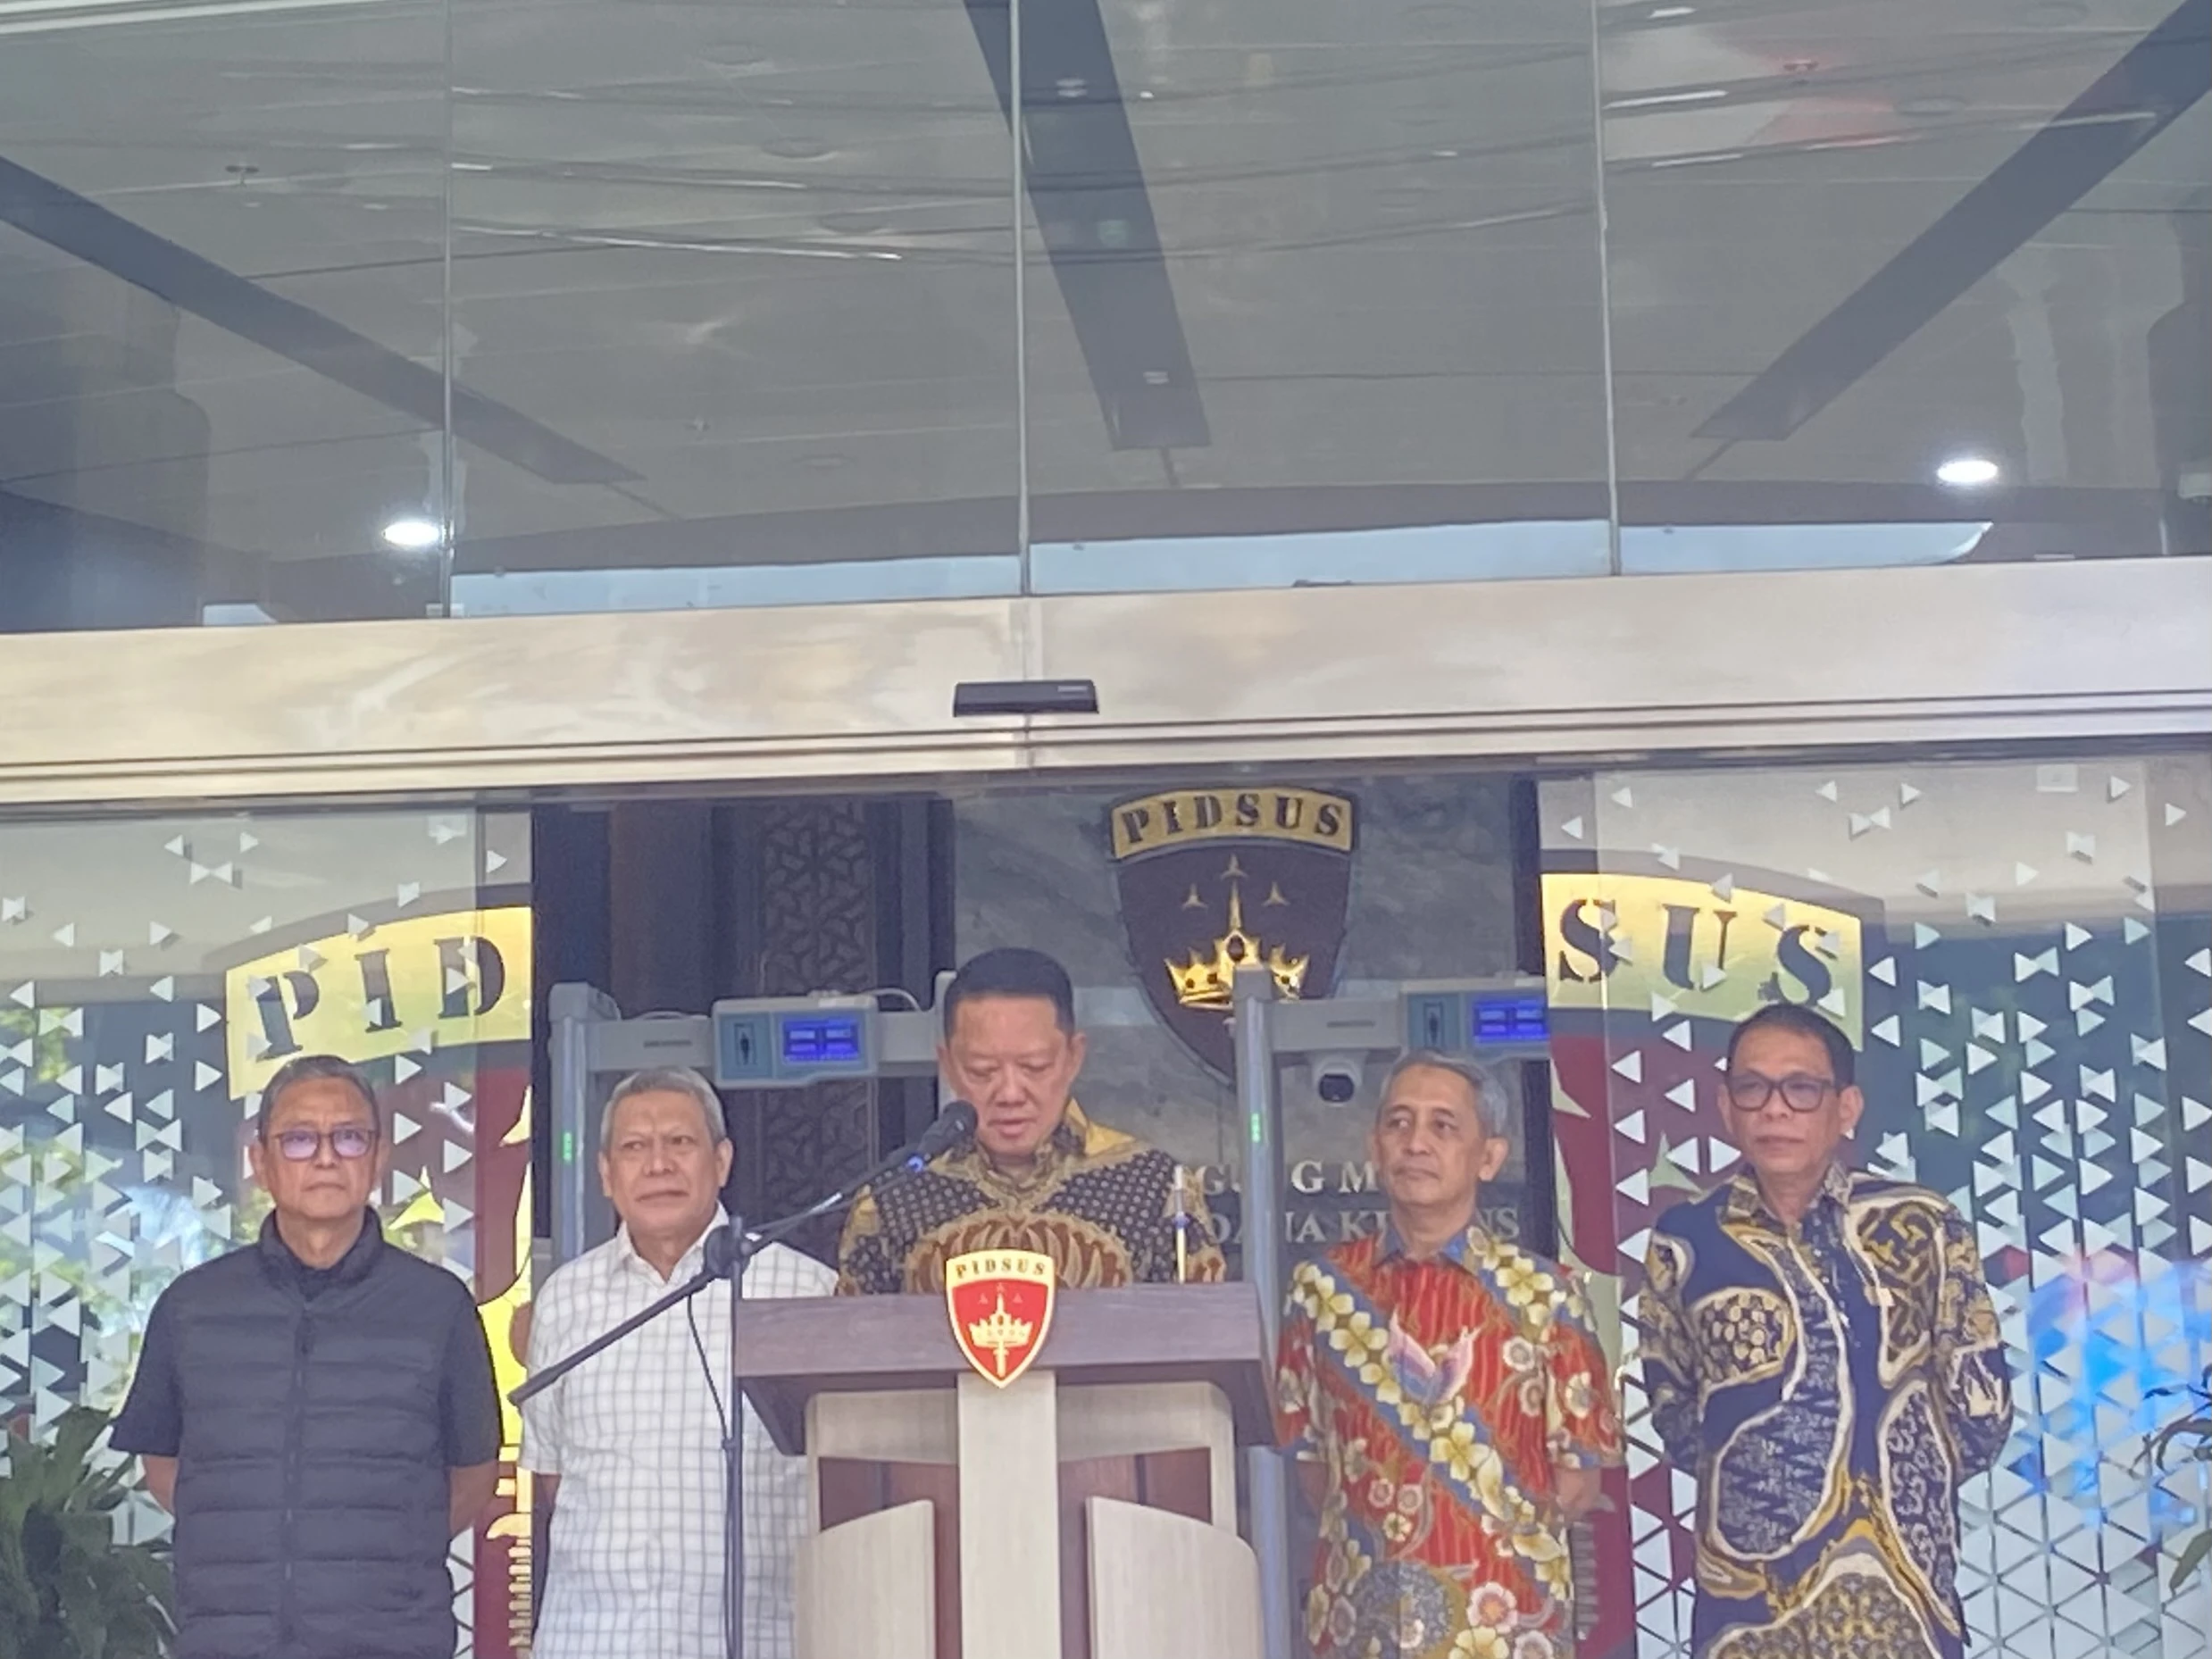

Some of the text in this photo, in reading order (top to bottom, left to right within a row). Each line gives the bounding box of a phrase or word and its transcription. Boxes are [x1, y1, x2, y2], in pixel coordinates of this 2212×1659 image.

[1121, 793, 1343, 844] PIDSUS
[1558, 897, 1839, 1005] SUS
[251, 935, 505, 1063] PID
[955, 1257, 1046, 1280] PIDSUS
